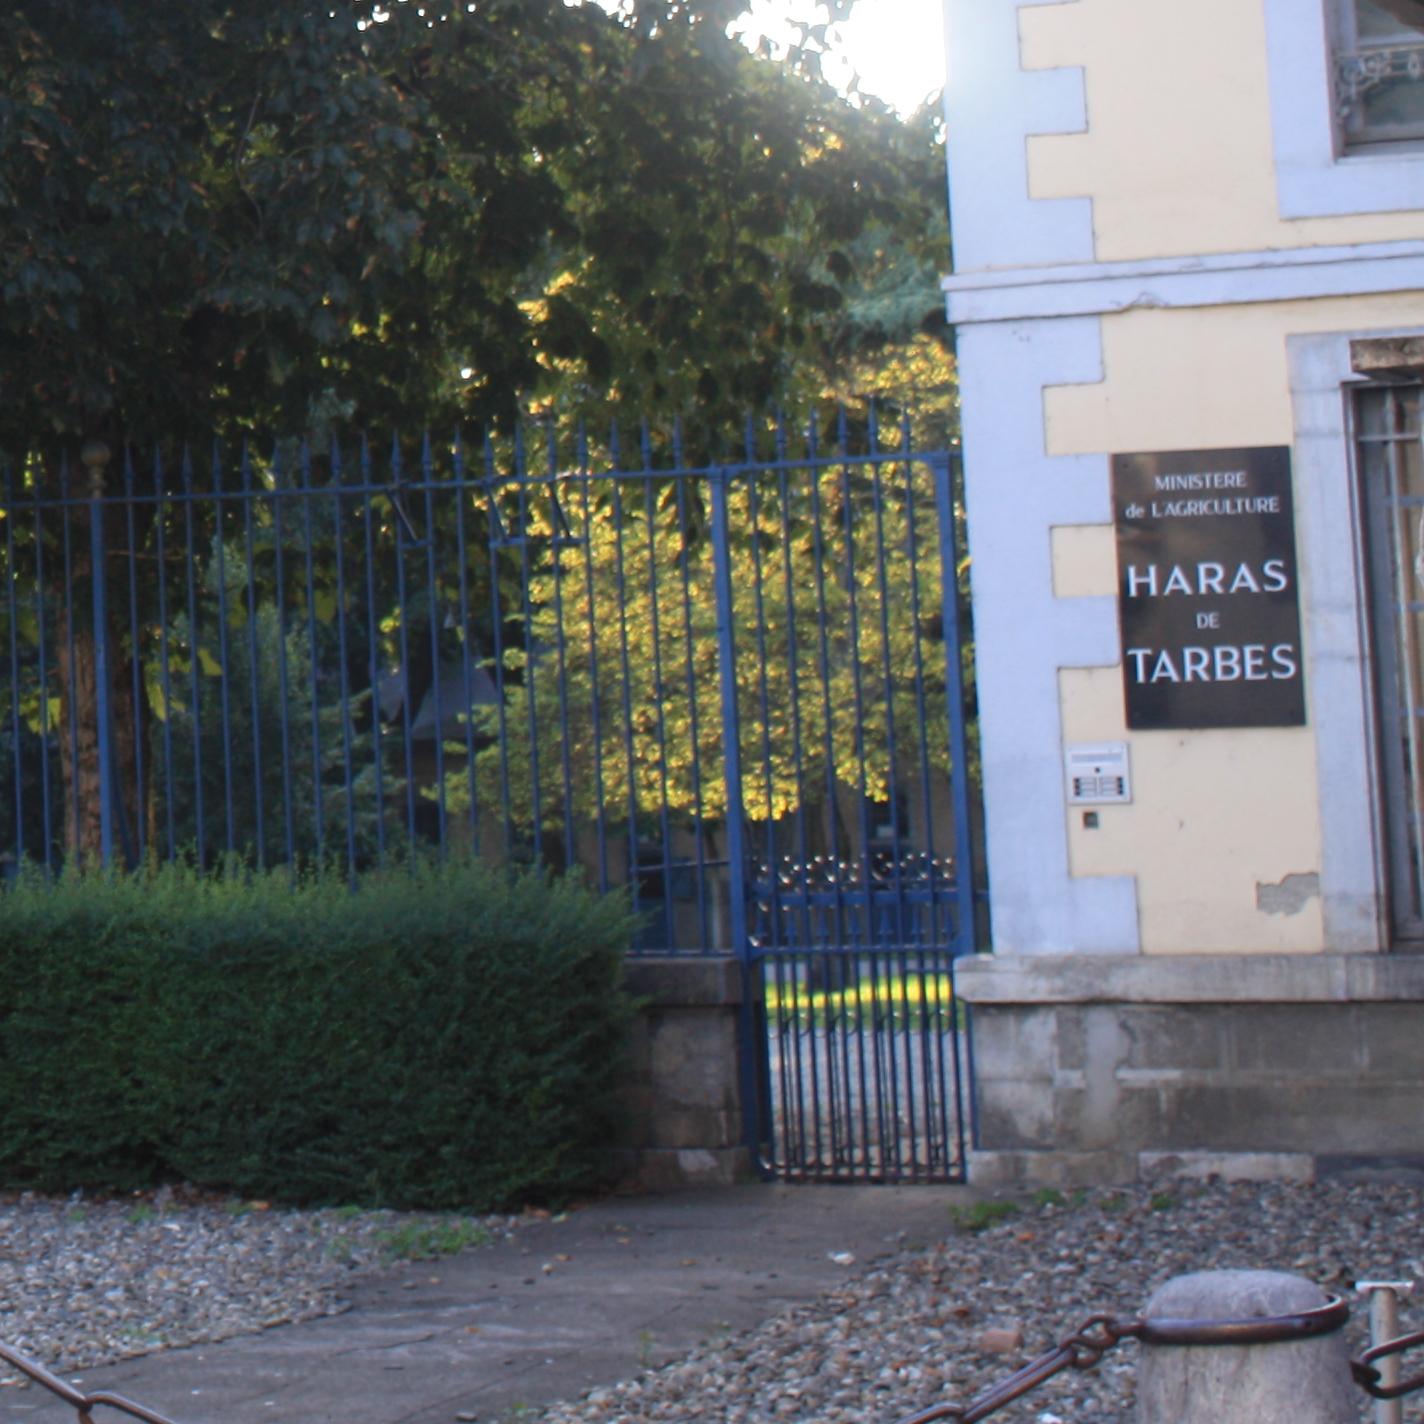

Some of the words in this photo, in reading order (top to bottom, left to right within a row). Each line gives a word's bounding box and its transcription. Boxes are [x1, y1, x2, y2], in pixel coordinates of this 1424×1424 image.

[1154, 471, 1247, 491] MINISTERE
[1126, 502, 1146, 519] de
[1151, 496, 1280, 517] L'AGRICULTURE
[1127, 560, 1288, 597] HARAS
[1196, 612, 1220, 629] DE
[1127, 644, 1297, 683] TARBES
